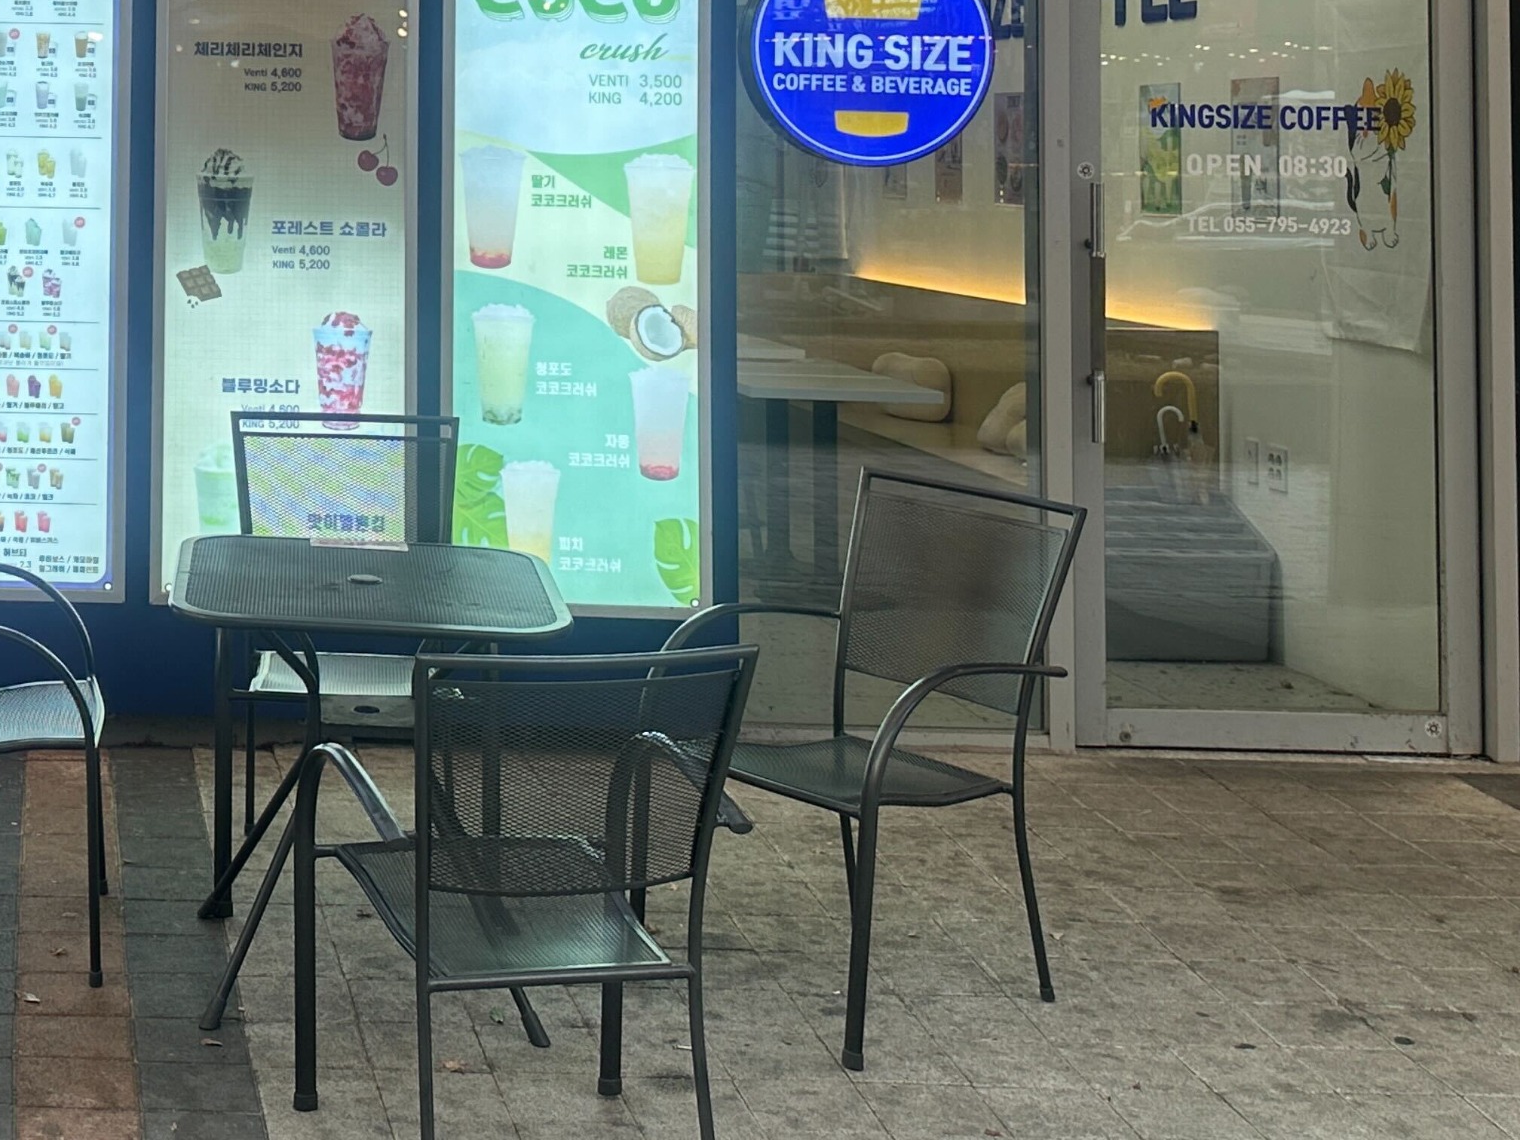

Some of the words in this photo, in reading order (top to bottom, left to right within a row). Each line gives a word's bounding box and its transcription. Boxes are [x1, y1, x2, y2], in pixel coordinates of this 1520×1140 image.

[194, 42, 303, 58] 체리체리체인지
[579, 33, 668, 62] crush
[774, 32, 873, 69] KING
[884, 35, 972, 72] SIZE
[244, 68, 268, 77] Venti
[270, 67, 302, 79] 4,600
[244, 82, 267, 91] KING
[270, 82, 302, 93] 5,200
[589, 75, 629, 87] VENTI
[639, 74, 682, 90] 3,500
[773, 73, 847, 92] COFFEE
[852, 75, 866, 93] &
[871, 76, 972, 96] BEVERAGE
[589, 92, 622, 104] KING
[639, 92, 682, 107] 4,200
[1150, 103, 1273, 129] KINGSIZE
[1186, 153, 1262, 177] OPEN
[1279, 155, 1347, 178] 08:30
[531, 174, 555, 189] 딸기
[531, 194, 592, 209] 코코크러쉬
[272, 220, 334, 236] 포레스트
[339, 221, 387, 238] 쇼콜라
[1188, 216, 1220, 232] TEL
[1224, 216, 1351, 235] 055-795-4923
[272, 245, 296, 255] Venti
[299, 245, 331, 257] 4,600
[603, 246, 628, 260] 레몬
[272, 260, 295, 270] KING
[298, 260, 331, 271] 5,200
[566, 264, 628, 279] 코코크러쉬
[536, 361, 572, 376] 청포도
[221, 378, 300, 394] 블루밍소다
[536, 382, 597, 397] 코코크러쉬
[242, 419, 265, 429] KING
[568, 453, 630, 468] 코코크러쉬
[559, 558, 621, 573] 코코크러쉬
